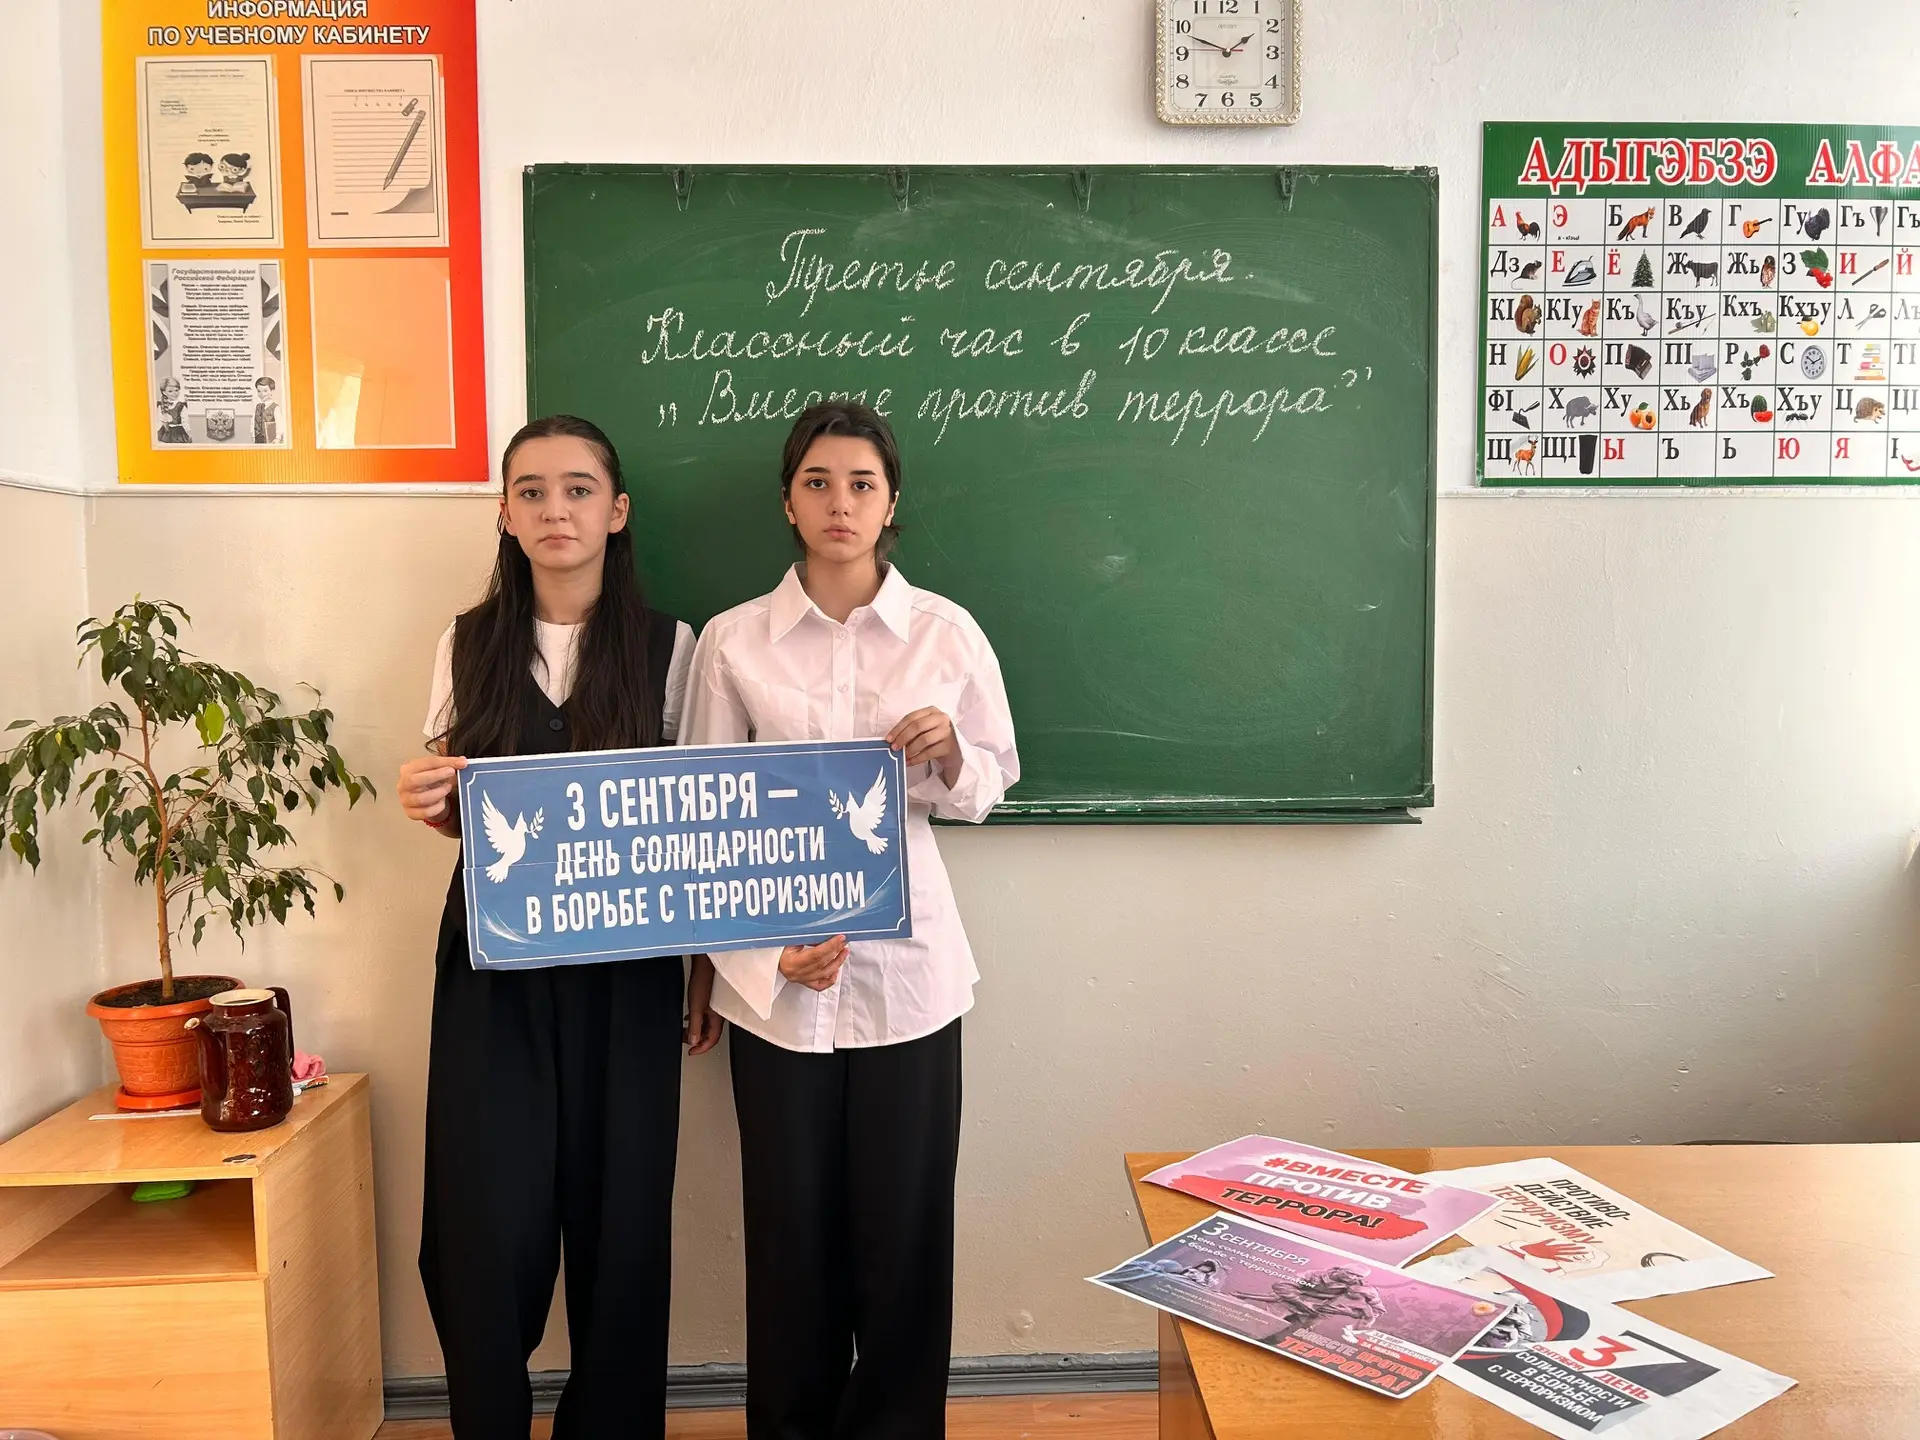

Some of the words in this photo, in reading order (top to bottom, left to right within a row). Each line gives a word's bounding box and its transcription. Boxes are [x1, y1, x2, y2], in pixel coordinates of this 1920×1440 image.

[207, 0, 367, 20] ИНФОРМАЦИЯ
[1194, 0, 1207, 14] 11
[1219, 0, 1239, 14] 12
[148, 26, 180, 46] ПО
[185, 25, 308, 46] УЧЕБНОМУ
[313, 25, 430, 45] КАБИНЕТУ
[1176, 19, 1191, 34] 10
[1266, 19, 1280, 33] 2
[1176, 46, 1189, 61] 9
[1266, 45, 1280, 60] 3
[1175, 74, 1189, 89] 8
[1264, 74, 1280, 89] 4
[1195, 93, 1208, 107] 7
[1221, 92, 1234, 107] 6
[1250, 92, 1263, 107] 5
[1519, 138, 1777, 194] АДЫГЭБЗЭ
[1491, 204, 1507, 227] А
[1552, 204, 1568, 227] Э
[1608, 204, 1623, 227] Б
[1668, 204, 1683, 227] В
[1728, 204, 1742, 227] Г
[1783, 205, 1808, 235] Гу
[1840, 205, 1865, 228] Гъ
[1490, 250, 1519, 278] Дз
[1551, 251, 1565, 273] Е
[1607, 248, 1621, 275] Ё
[1666, 252, 1688, 275] Ж
[1727, 252, 1760, 275] Жь
[1782, 252, 1796, 275] З
[1839, 252, 1857, 274] И
[1896, 247, 1913, 275] Й
[766, 228, 956, 318] Третье
[1606, 298, 1635, 321] Къ
[1666, 298, 1706, 328] Къу
[1722, 295, 1762, 317] Кхъ
[1779, 295, 1831, 325] Кхъу
[1837, 298, 1855, 320] Л
[642, 307, 915, 364] Классный
[940, 327, 1023, 358] час
[1051, 312, 1091, 356] в
[1118, 326, 1169, 364] 10
[1178, 326, 1337, 356] классе
[1488, 343, 1507, 365] Н
[1549, 343, 1567, 365] О
[1605, 343, 1623, 365] П
[1725, 343, 1739, 365] Р
[1780, 341, 1795, 365] С
[1837, 343, 1852, 365] Т
[918, 368, 1097, 446] против
[1548, 388, 1565, 409] Х
[1604, 388, 1632, 417] Ху
[1663, 389, 1691, 411] Хь
[1721, 387, 1750, 409] Хъ
[1777, 387, 1822, 420] Хъу
[1835, 389, 1853, 415] Ц
[1487, 438, 1512, 465] Щ
[1603, 438, 1625, 460] Ы
[1662, 438, 1680, 460] Ъ
[1722, 438, 1737, 460] Ь
[1777, 438, 1800, 460] Ю
[1834, 438, 1850, 459] Я
[566, 782, 586, 831] 3
[600, 772, 758, 828] СЕНТЯБРЯ
[555, 841, 620, 886] ДЕНЬ
[630, 826, 825, 875] СОЛИДАРНОСТИ
[526, 895, 542, 935] В
[552, 887, 649, 932] БОРЬБЕ
[659, 885, 675, 923] С
[683, 870, 866, 922] ТЕРРОРИЗМОМ
[1263, 1157, 1429, 1193] #ВМЕСТЕ
[1243, 1172, 1392, 1210] ПРОТИВ
[1547, 1179, 1630, 1221] ПРОТИВО-
[1220, 1187, 1385, 1228] ТЕРРОРА!
[1490, 1185, 1604, 1244] ТЕРРОРИЗМУ
[1514, 1184, 1613, 1229] ДЕЙСТВИЕ
[1201, 1221, 1230, 1236] 3
[1219, 1232, 1310, 1266] СЕНТЯБРЯ
[1293, 1328, 1359, 1356] ВМЕСТЕ
[1355, 1351, 1423, 1381] ПРОТИВ
[1532, 1344, 1586, 1371] СЕНТЯБРЯ
[1569, 1335, 1638, 1367] 3
[1276, 1336, 1412, 1393] ТЕРРОРА!
[1515, 1351, 1631, 1408] СОЛИДАРНОСТИ
[1521, 1367, 1532, 1376] В
[1534, 1373, 1600, 1406] БОРЬБЕ
[1594, 1373, 1650, 1400] ДЕНЬ
[1487, 1364, 1499, 1373] С
[1500, 1370, 1604, 1423] ТЕРРОРИЗМОМ
